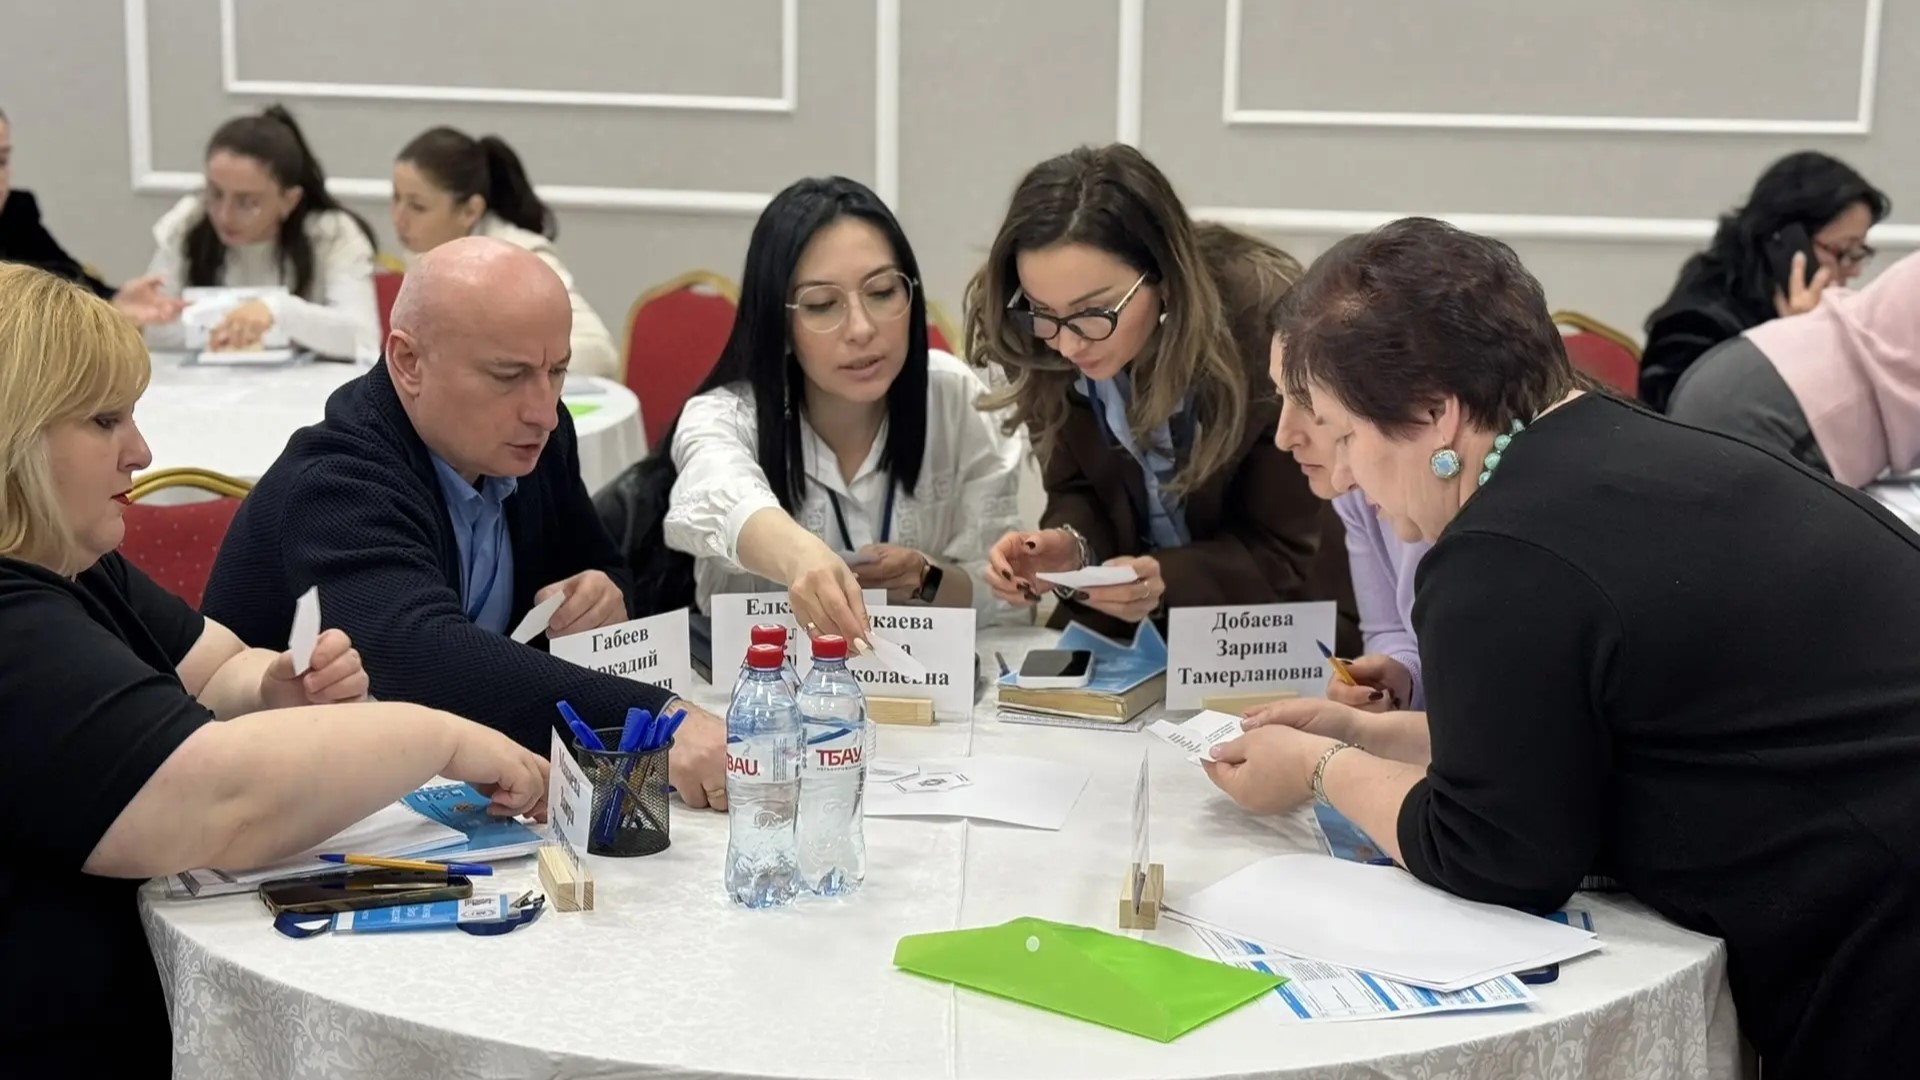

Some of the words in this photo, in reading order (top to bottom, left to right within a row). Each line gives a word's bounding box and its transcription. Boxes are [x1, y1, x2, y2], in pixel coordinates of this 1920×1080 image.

[868, 615, 934, 630] каева
[1211, 611, 1294, 633] Добаева
[592, 627, 649, 653] Габеев
[1216, 638, 1288, 660] Зарина
[1178, 665, 1323, 687] Тамерлановна
[726, 752, 758, 776] BAU
[816, 745, 863, 767] ТБАУ
